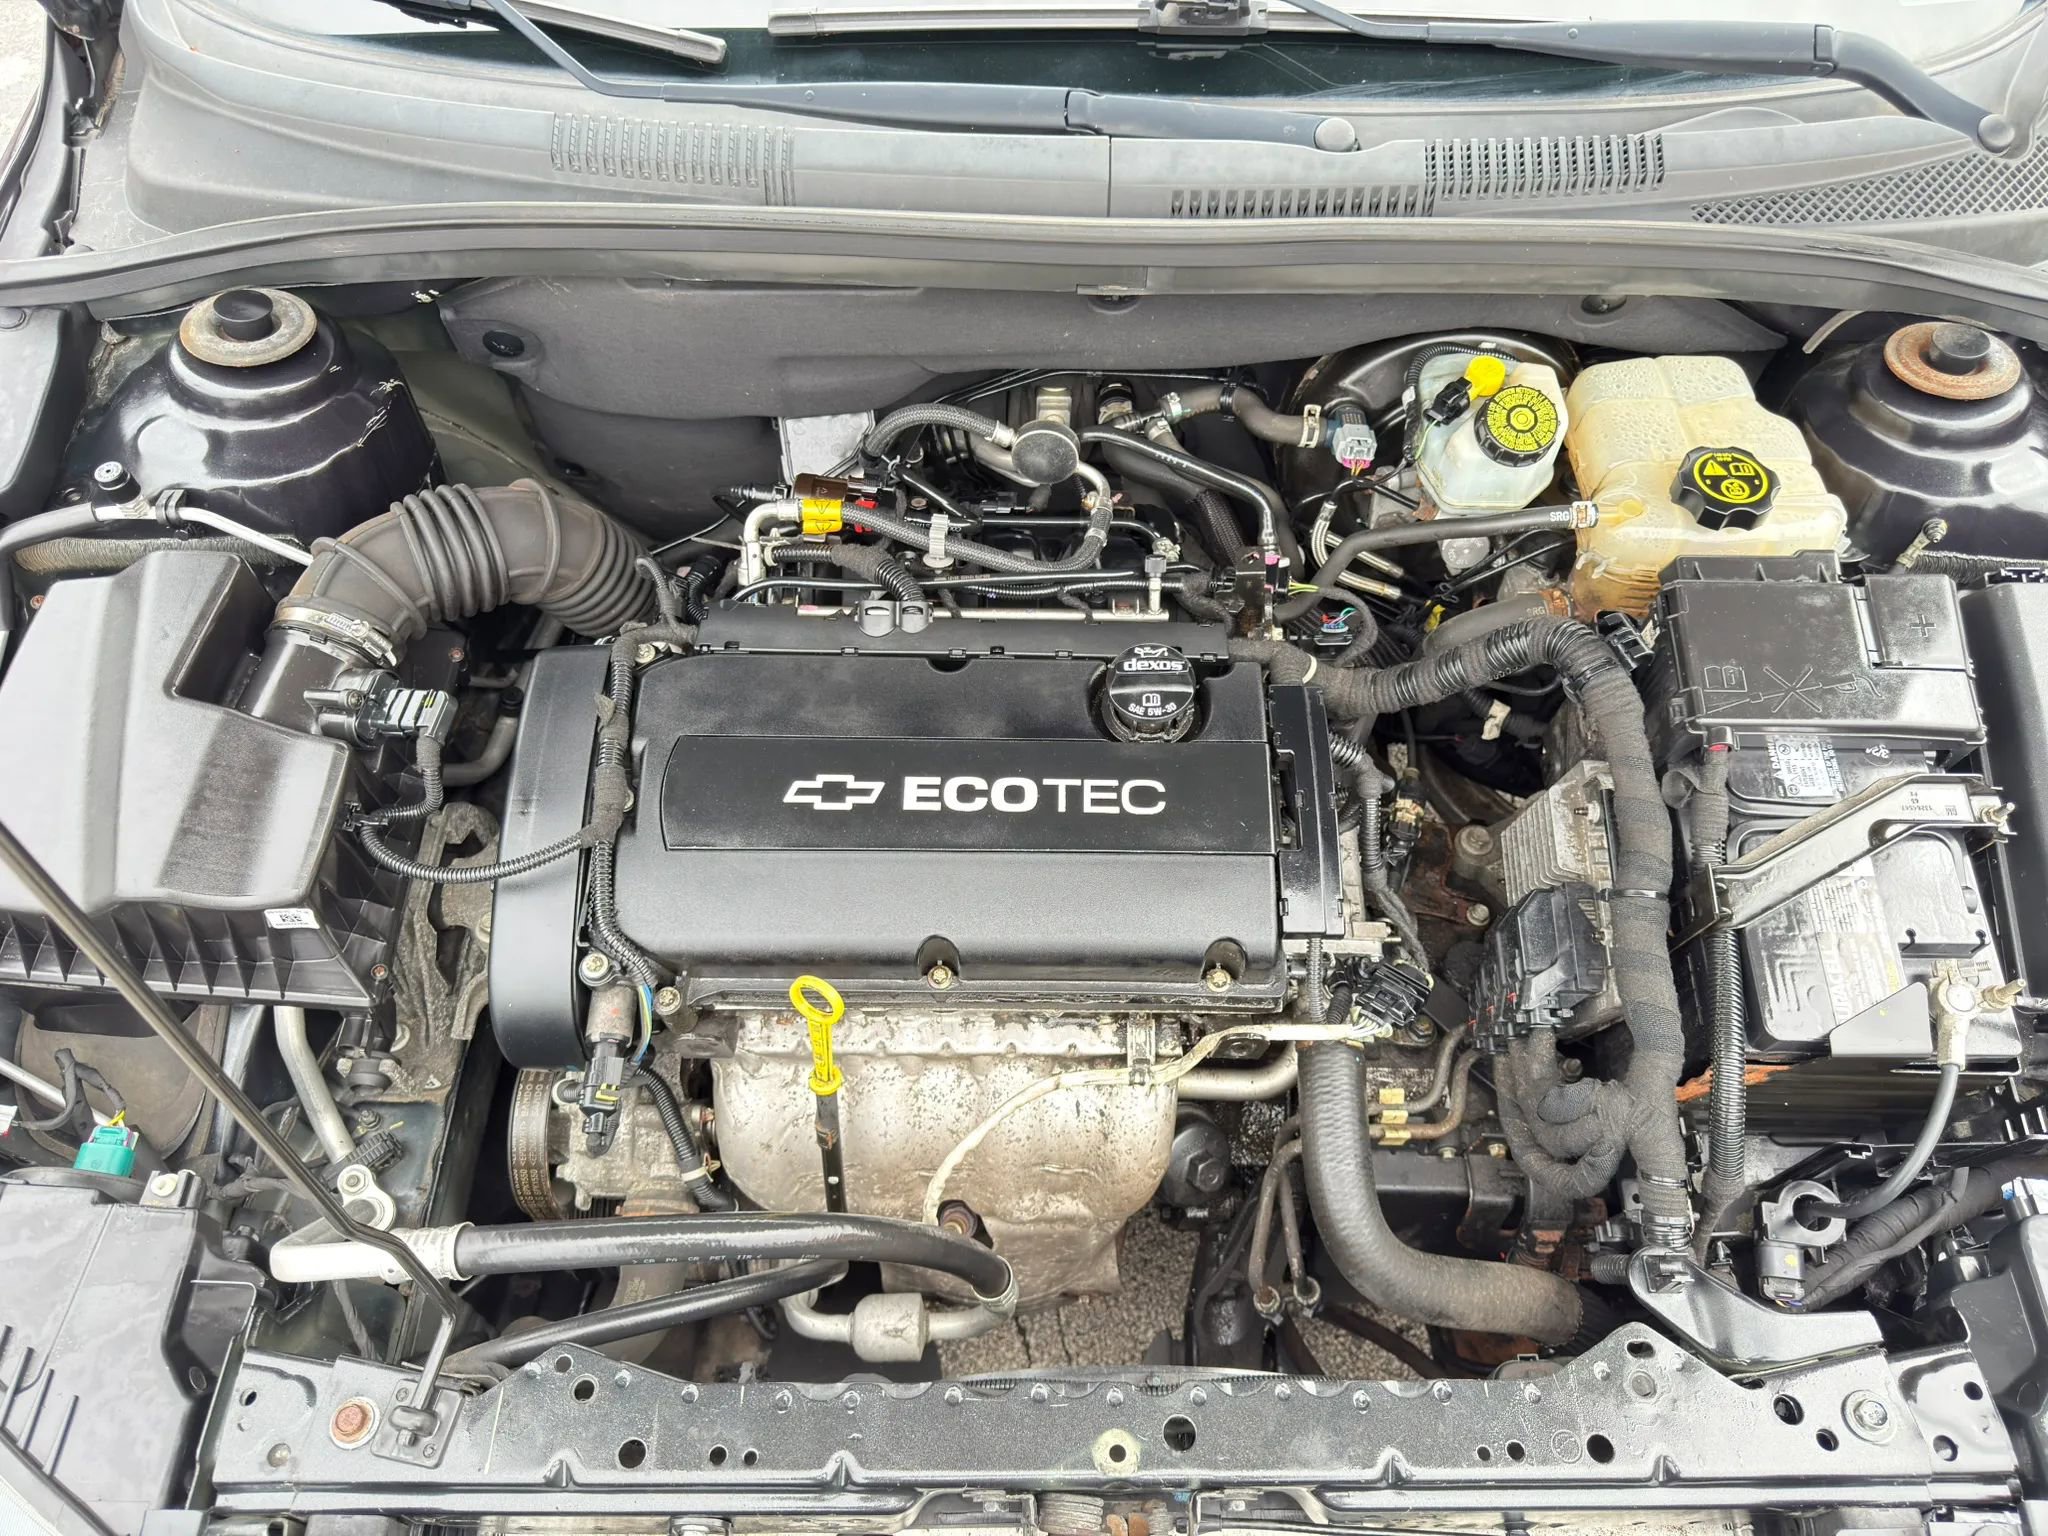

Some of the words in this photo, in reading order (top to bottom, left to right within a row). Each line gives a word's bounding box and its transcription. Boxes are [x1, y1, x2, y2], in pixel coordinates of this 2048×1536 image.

[1549, 511, 1570, 522] SRG
[1123, 658, 1185, 671] dexos
[1128, 703, 1146, 716] SAE
[1147, 702, 1177, 716] 5W-30
[902, 776, 1167, 815] ECOTEC
[520, 1083, 533, 1117] BANDO
